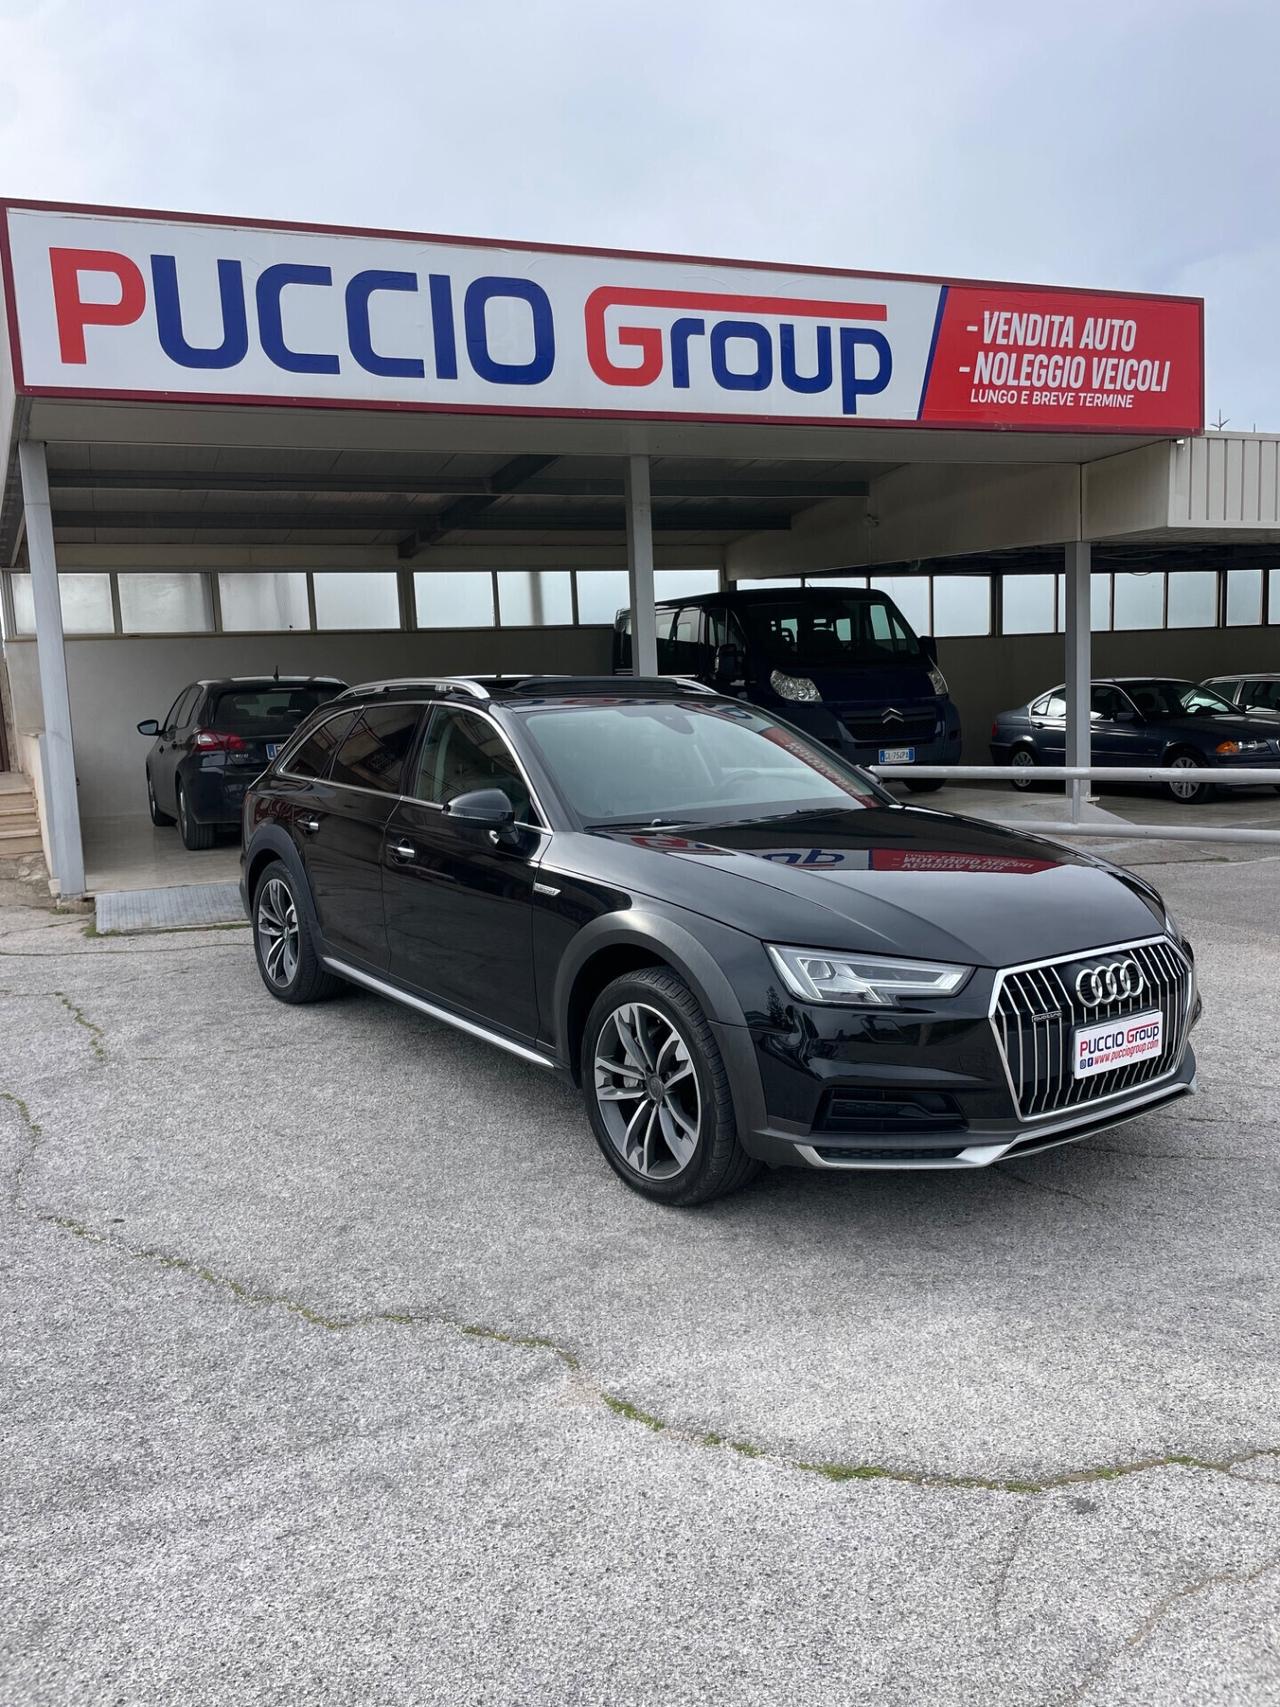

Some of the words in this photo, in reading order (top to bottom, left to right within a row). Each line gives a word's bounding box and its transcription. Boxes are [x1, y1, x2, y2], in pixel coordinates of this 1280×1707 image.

[48, 247, 556, 385] PUCCIO
[584, 286, 893, 415] Group
[1079, 318, 1137, 352] AUTO
[1092, 357, 1171, 392] VEICOLI
[970, 388, 1018, 405] LUNGO
[1020, 390, 1030, 405] E
[1031, 390, 1075, 407] BREVE
[1079, 393, 1135, 408] TERMINE
[1080, 1031, 1125, 1057] PUCCIO
[1126, 1021, 1160, 1044] Group
